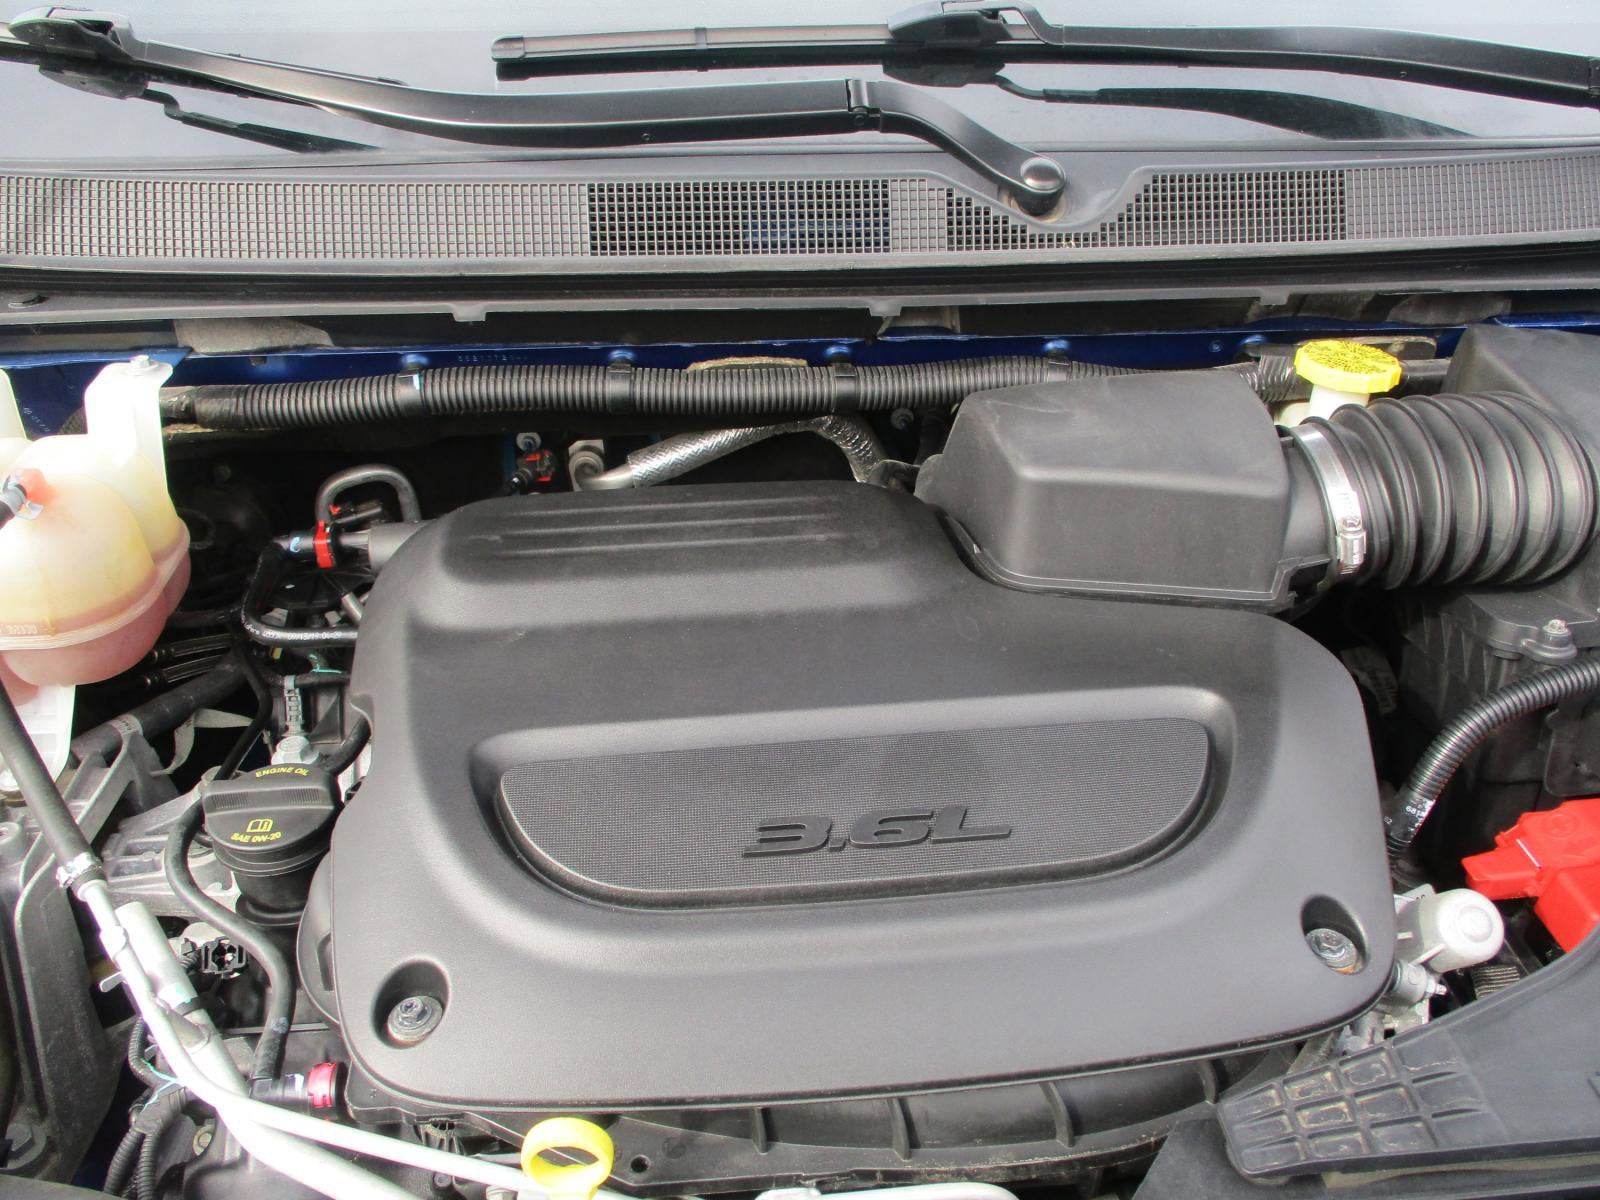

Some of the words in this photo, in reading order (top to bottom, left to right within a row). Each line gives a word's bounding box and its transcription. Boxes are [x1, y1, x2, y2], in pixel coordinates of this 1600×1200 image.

[255, 766, 293, 778] ENGINE
[294, 767, 309, 776] OIL
[230, 832, 250, 843] SAE
[251, 831, 282, 843] 0W-20
[742, 804, 1011, 858] 3.6L
